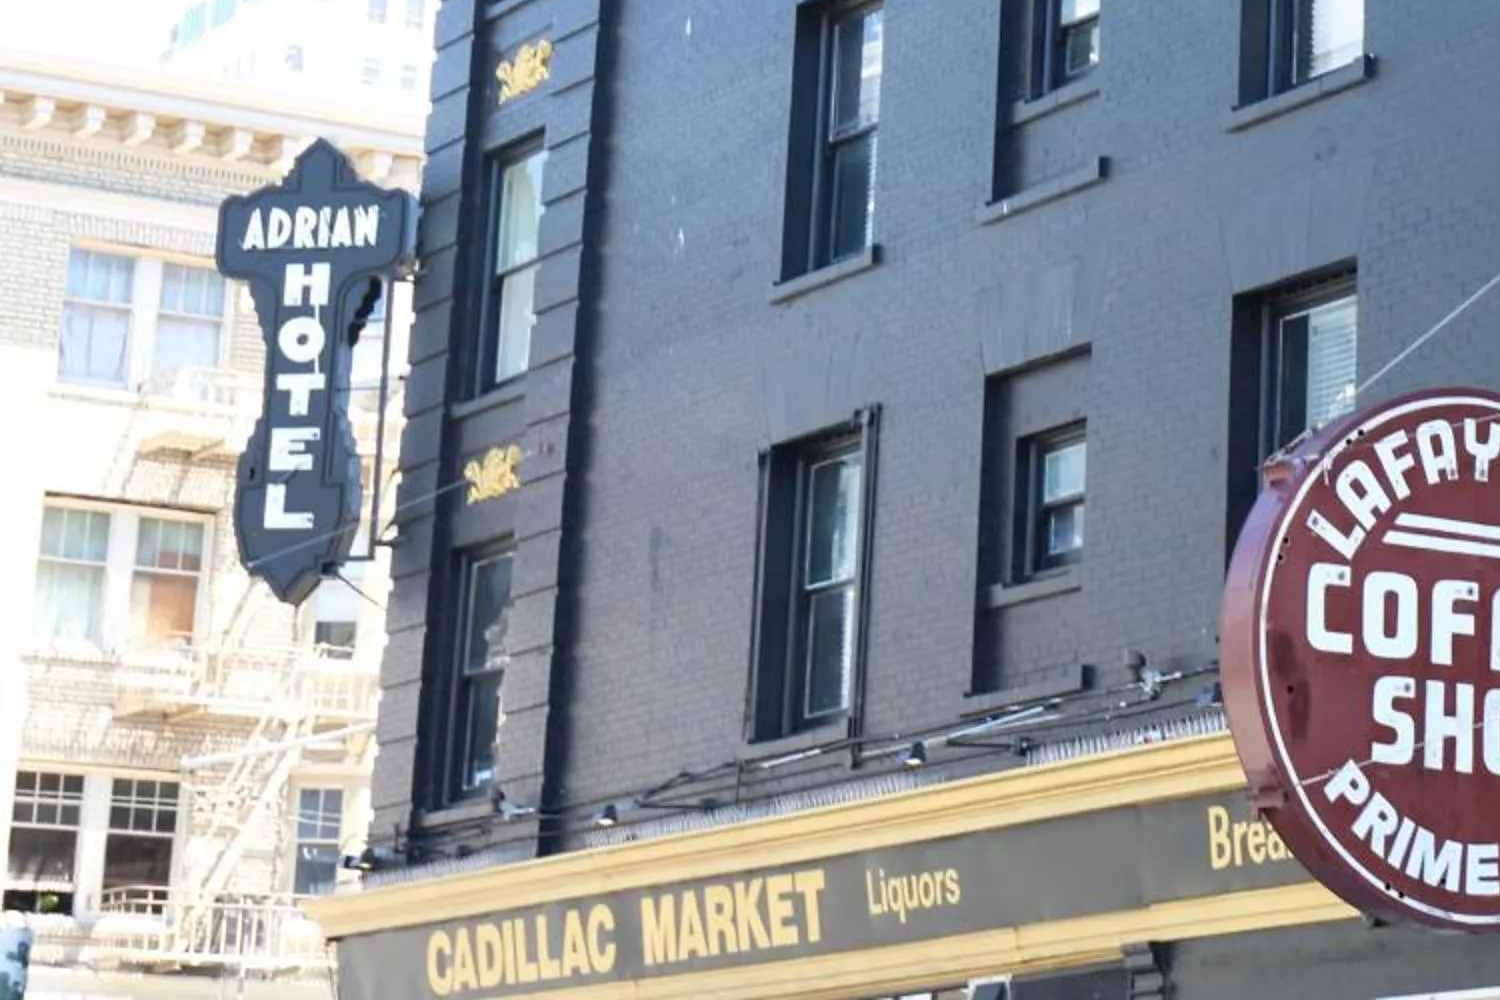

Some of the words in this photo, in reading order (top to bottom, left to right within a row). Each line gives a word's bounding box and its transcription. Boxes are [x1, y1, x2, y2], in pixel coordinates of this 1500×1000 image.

[242, 204, 379, 250] ADRIAN
[263, 262, 331, 530] HOTEL
[1207, 804, 1295, 871] Brea
[1323, 759, 1500, 896] PRIME
[426, 903, 617, 996] CADILLAC
[641, 869, 826, 966] MARKET
[866, 867, 961, 922] Liquors
